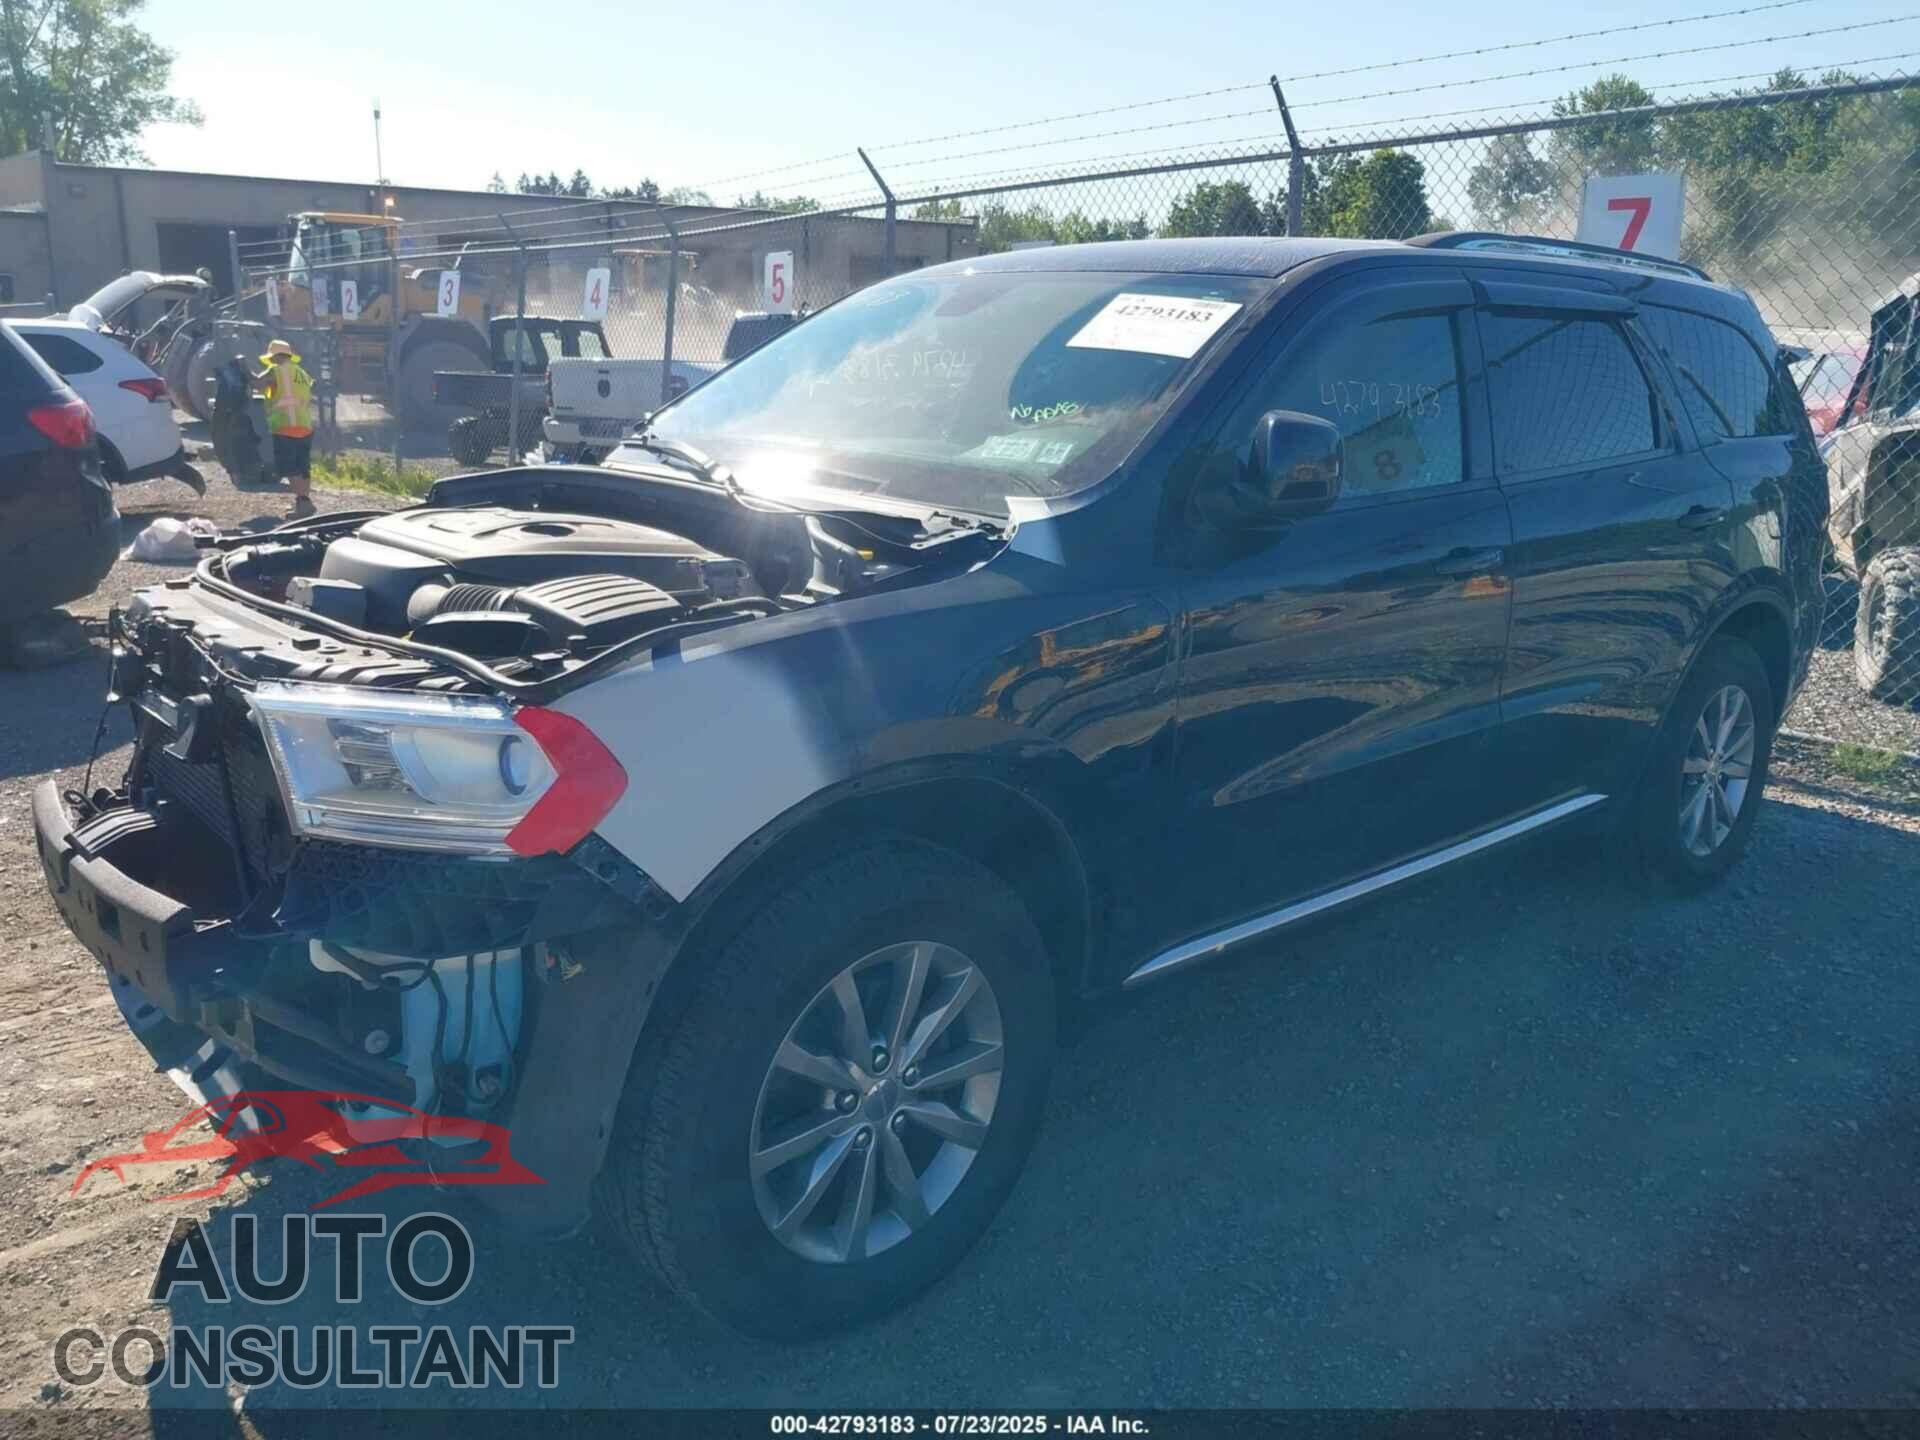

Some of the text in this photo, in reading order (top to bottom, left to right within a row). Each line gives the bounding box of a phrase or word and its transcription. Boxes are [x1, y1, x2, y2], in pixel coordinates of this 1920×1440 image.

[1607, 197, 1652, 250] 7
[443, 279, 455, 306] 3
[590, 278, 602, 309] 4
[772, 263, 785, 303] 5
[344, 287, 354, 314] 2
[1114, 304, 1214, 323] 42793183
[1320, 379, 1381, 420] 4279
